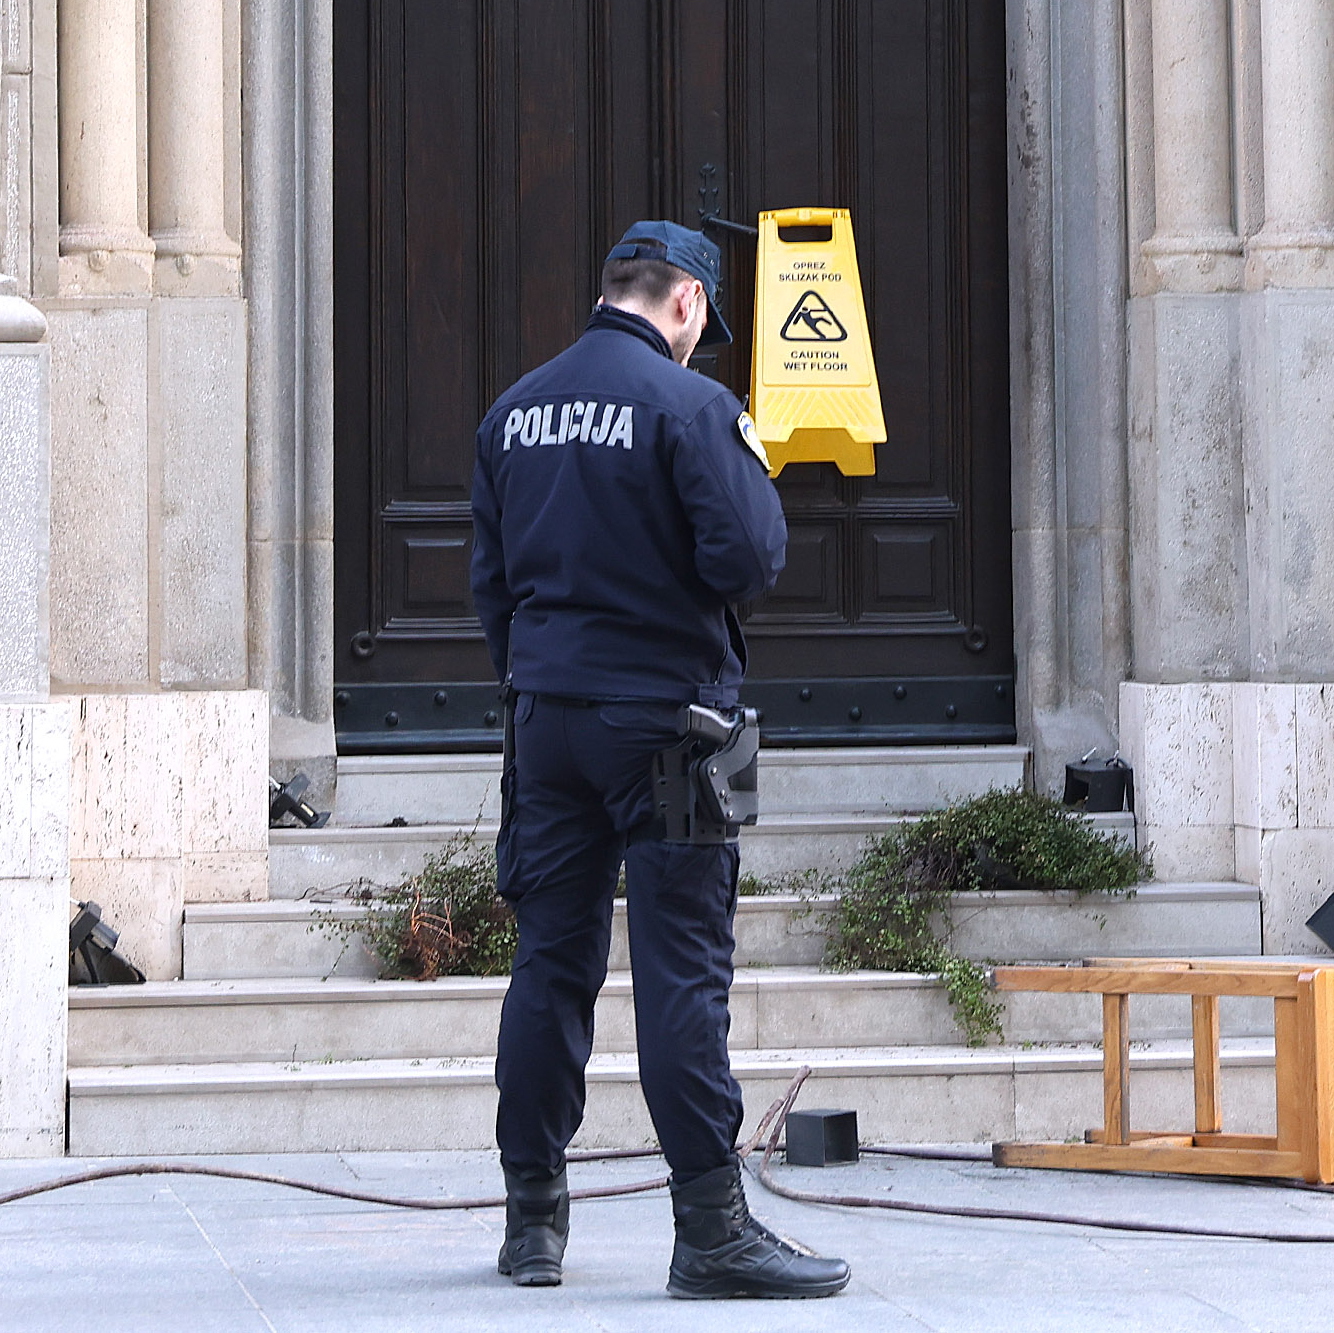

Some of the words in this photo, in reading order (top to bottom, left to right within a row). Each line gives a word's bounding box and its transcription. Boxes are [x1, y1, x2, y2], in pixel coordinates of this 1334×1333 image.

[793, 261, 826, 270] OPREZ
[779, 273, 819, 282] SKLIZAK
[821, 273, 842, 282] POD
[790, 350, 839, 359] CAUTION
[784, 361, 808, 371] WET
[810, 361, 848, 371] FLOOR
[503, 400, 633, 451] POLICIJA
